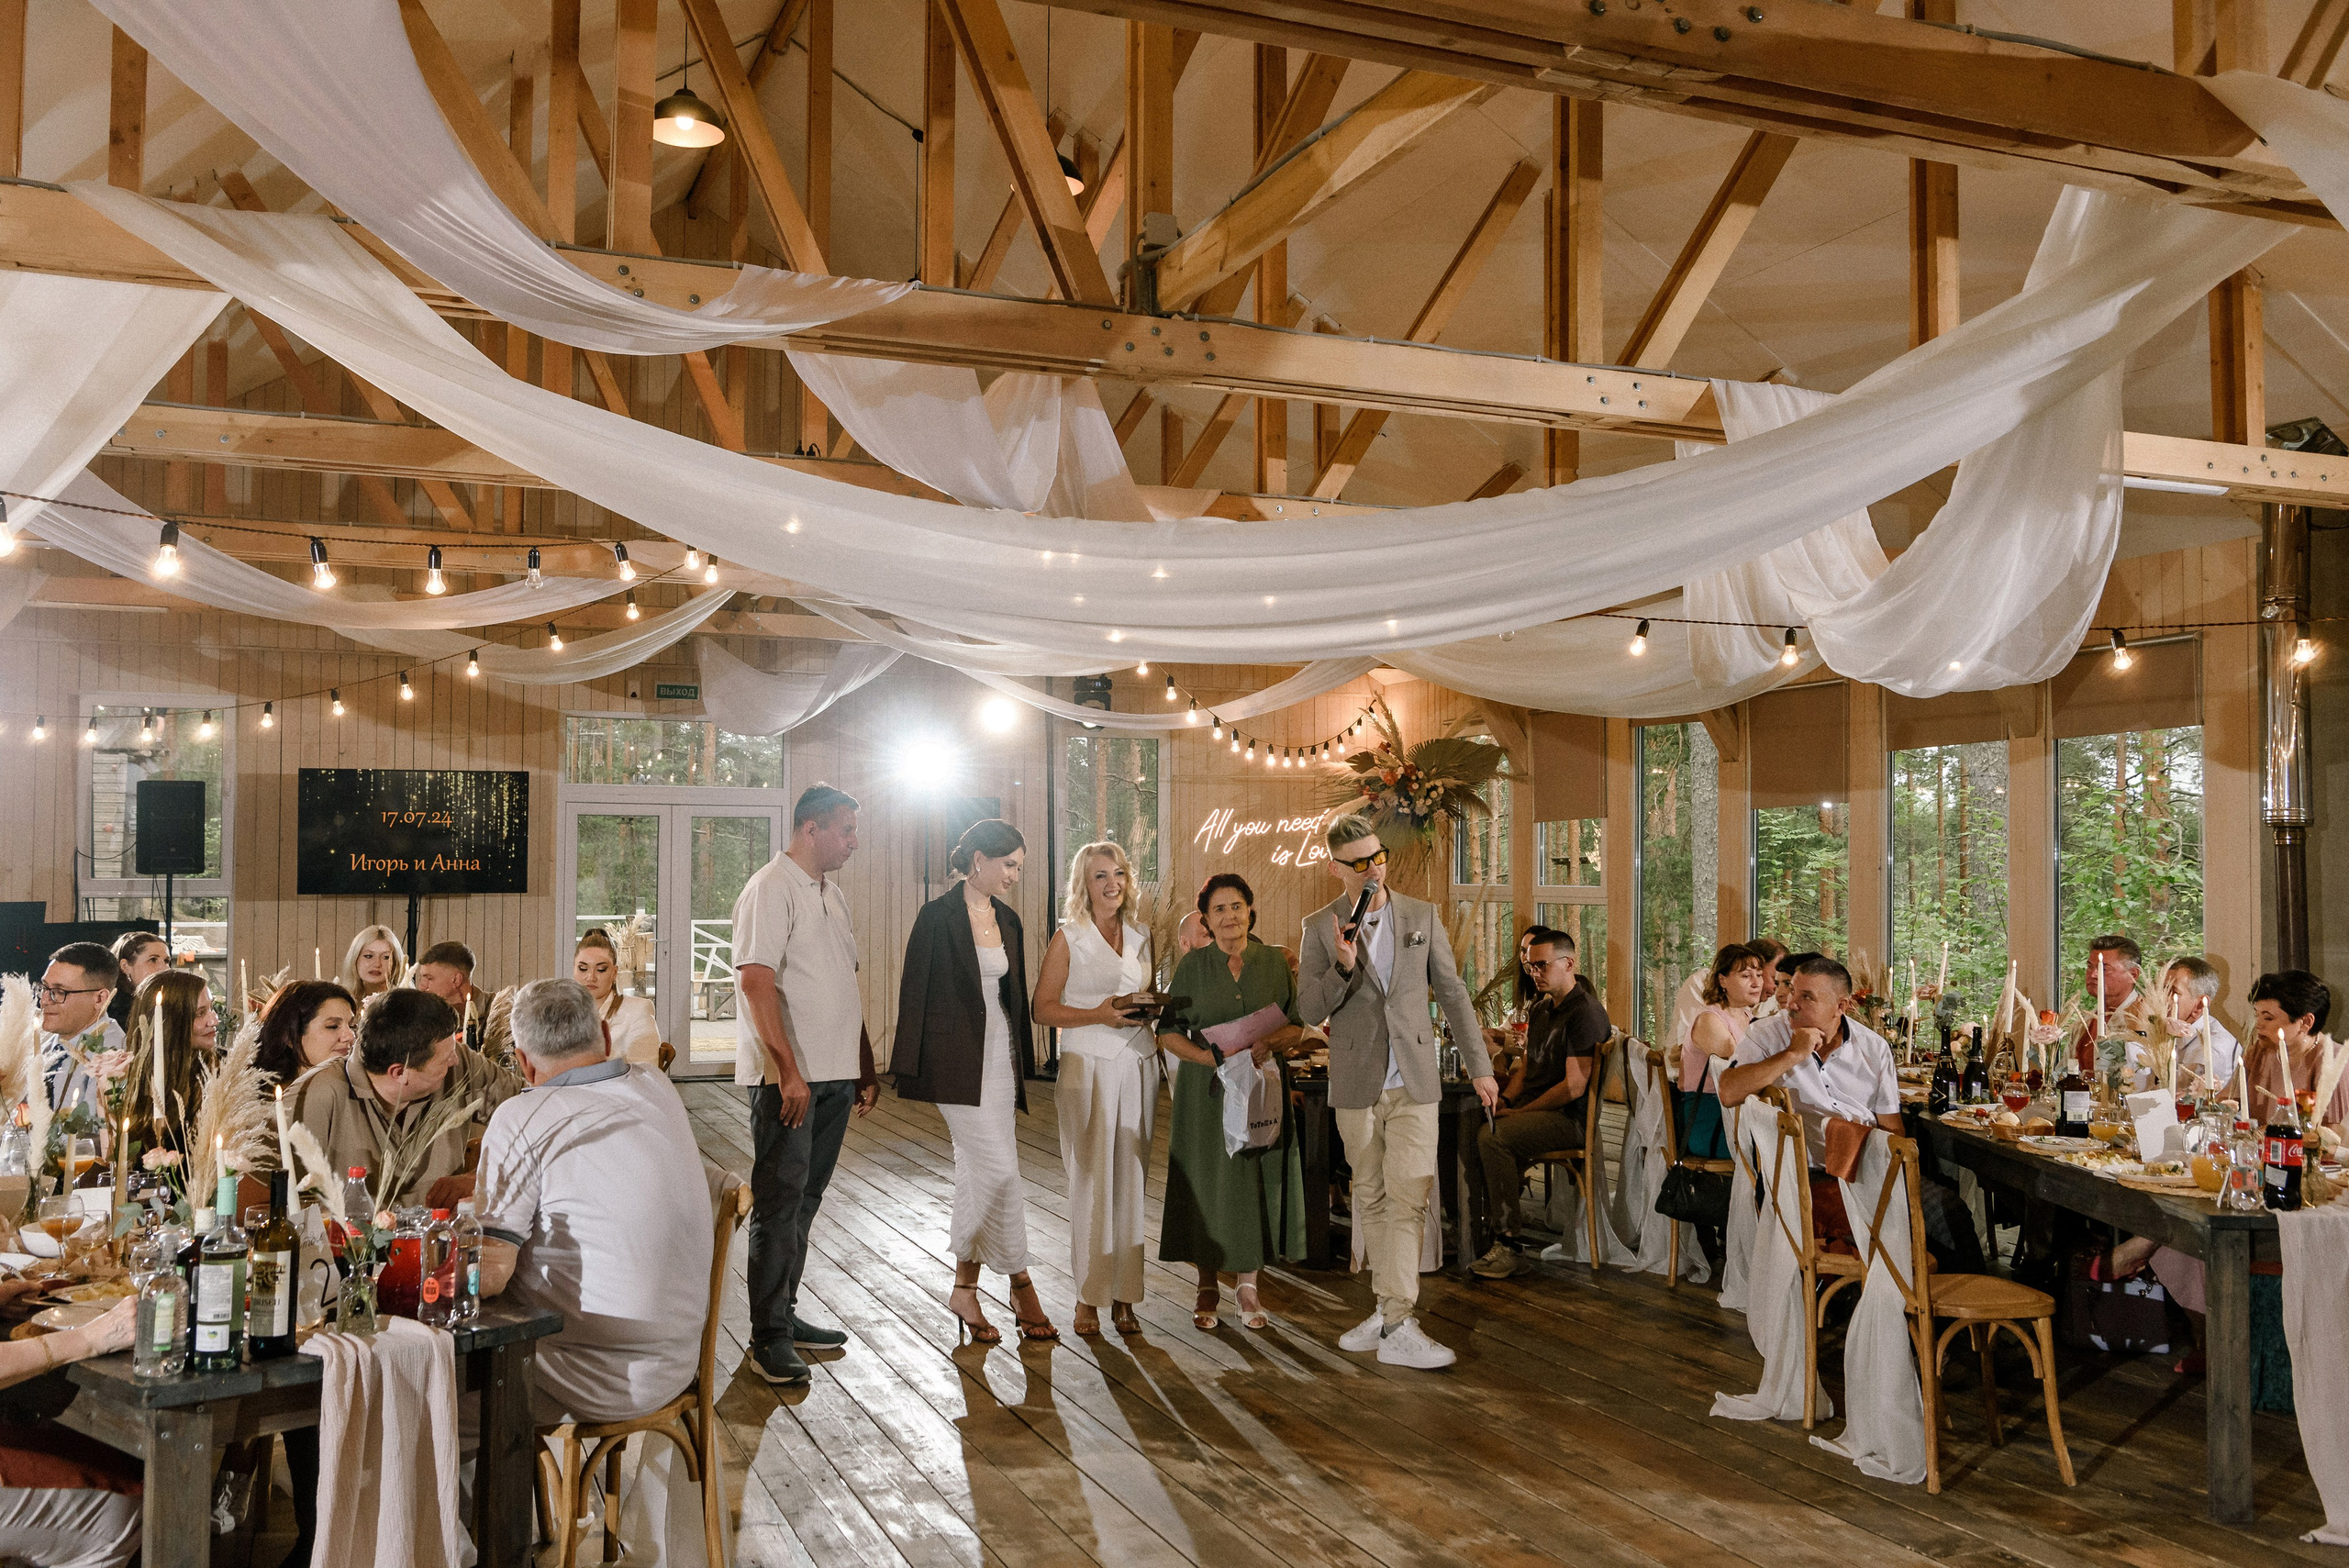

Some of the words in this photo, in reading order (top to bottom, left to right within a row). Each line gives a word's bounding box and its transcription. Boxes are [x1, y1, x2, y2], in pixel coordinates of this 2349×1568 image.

[660, 687, 696, 697] ВЫХОД
[381, 811, 453, 828] 17.07.24
[1194, 808, 1234, 852] All
[1223, 821, 1273, 854] you
[1271, 844, 1294, 866] is
[1295, 830, 1329, 867] Lov
[350, 853, 408, 877] Игорь
[414, 859, 427, 871] и
[430, 853, 481, 871] Анна
[310, 1258, 339, 1308] 2
